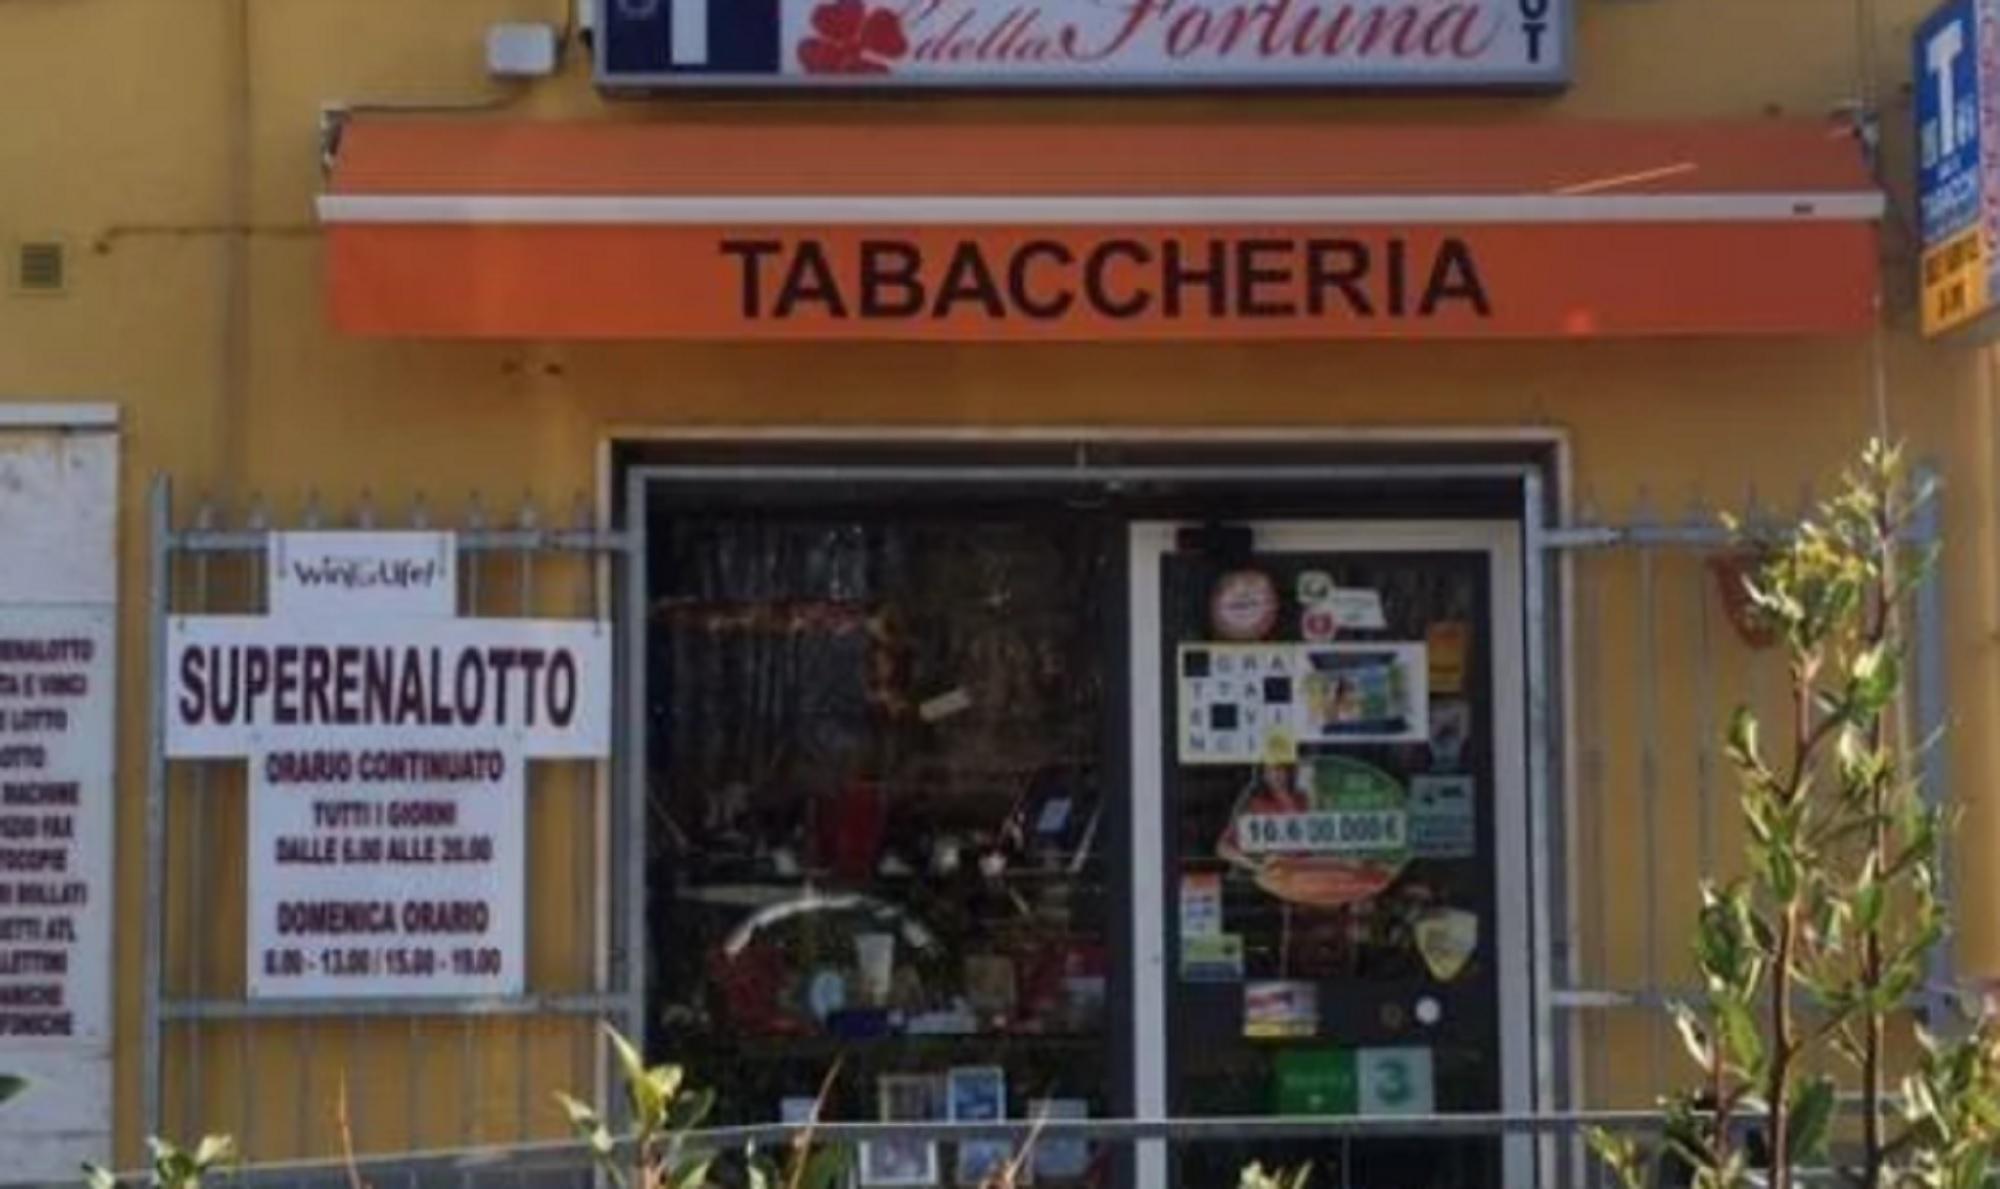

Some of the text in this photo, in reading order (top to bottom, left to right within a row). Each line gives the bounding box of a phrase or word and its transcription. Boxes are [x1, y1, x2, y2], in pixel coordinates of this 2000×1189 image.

[914, 7, 1052, 60] della
[720, 240, 1491, 318] TABACCHERIA
[179, 645, 577, 727] SUPERENALOTTO
[266, 749, 505, 784] ORARIO CONTINUATO
[42, 814, 75, 838] FAX
[313, 801, 370, 827] TUTTI
[388, 801, 457, 827] GIORNI
[276, 837, 337, 863] DALLE
[387, 837, 435, 862] ALLE
[18, 881, 88, 906] BOLLATI
[277, 901, 490, 935] DOMENICA ORARIO
